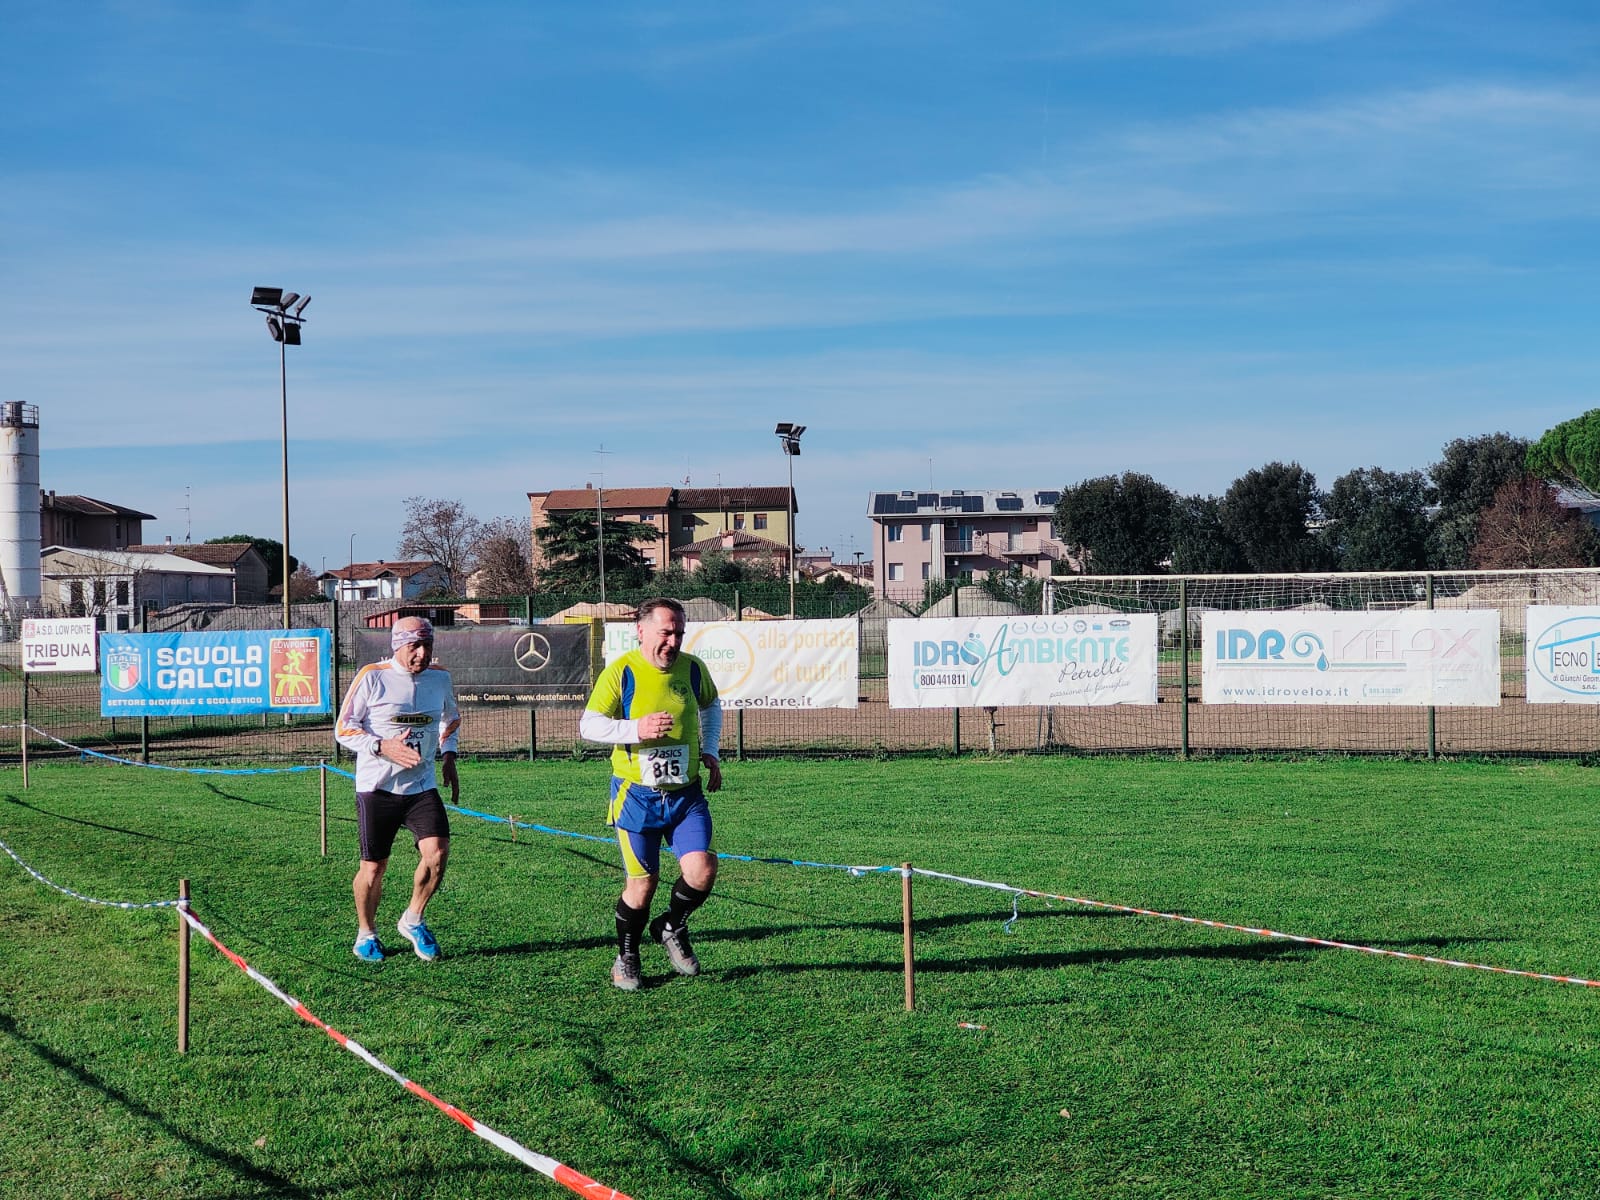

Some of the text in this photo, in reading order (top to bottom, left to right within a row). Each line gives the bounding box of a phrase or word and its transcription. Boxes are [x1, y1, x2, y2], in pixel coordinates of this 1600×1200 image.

[55, 624, 70, 635] LOW
[71, 624, 91, 634] PONTE
[757, 626, 855, 655] alla portata
[25, 643, 91, 658] TRIBUNA
[156, 645, 263, 666] SCUOLA
[693, 646, 735, 659] valore
[774, 662, 789, 682] di
[796, 660, 832, 682] tutti
[1058, 657, 1125, 683] Petrelli
[156, 667, 263, 689] CALCIO
[457, 692, 585, 701] Imola Cesena www.destefani.net
[1223, 686, 1349, 697] www.idrovelox.it
[149, 698, 196, 706] GIOVANILE
[274, 695, 316, 704] RAVENNA
[720, 695, 812, 707] oresolare.it
[658, 749, 682, 758] asics
[653, 760, 681, 778] 815
